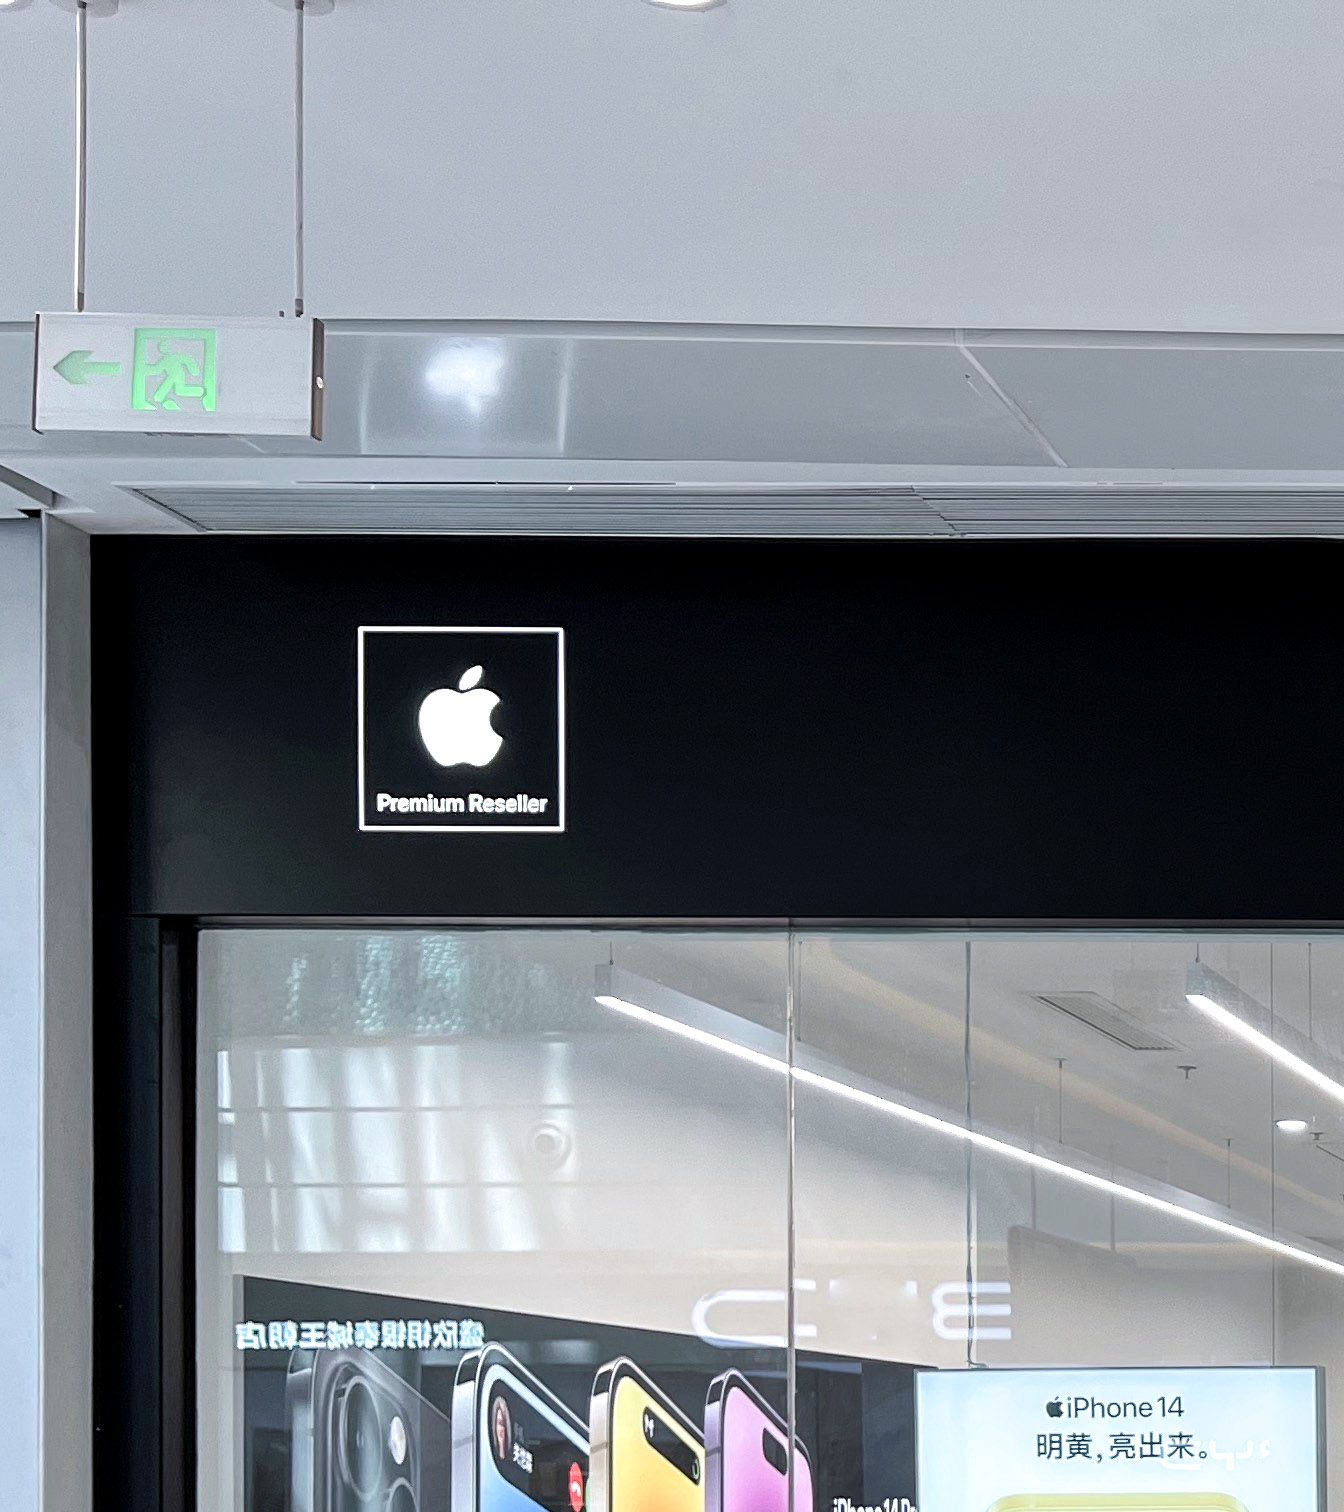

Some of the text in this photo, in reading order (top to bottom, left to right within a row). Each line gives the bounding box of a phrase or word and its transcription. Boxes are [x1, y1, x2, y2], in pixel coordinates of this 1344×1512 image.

[376, 793, 549, 813] Premium Reseller
[1066, 1396, 1185, 1419] iPhone 14
